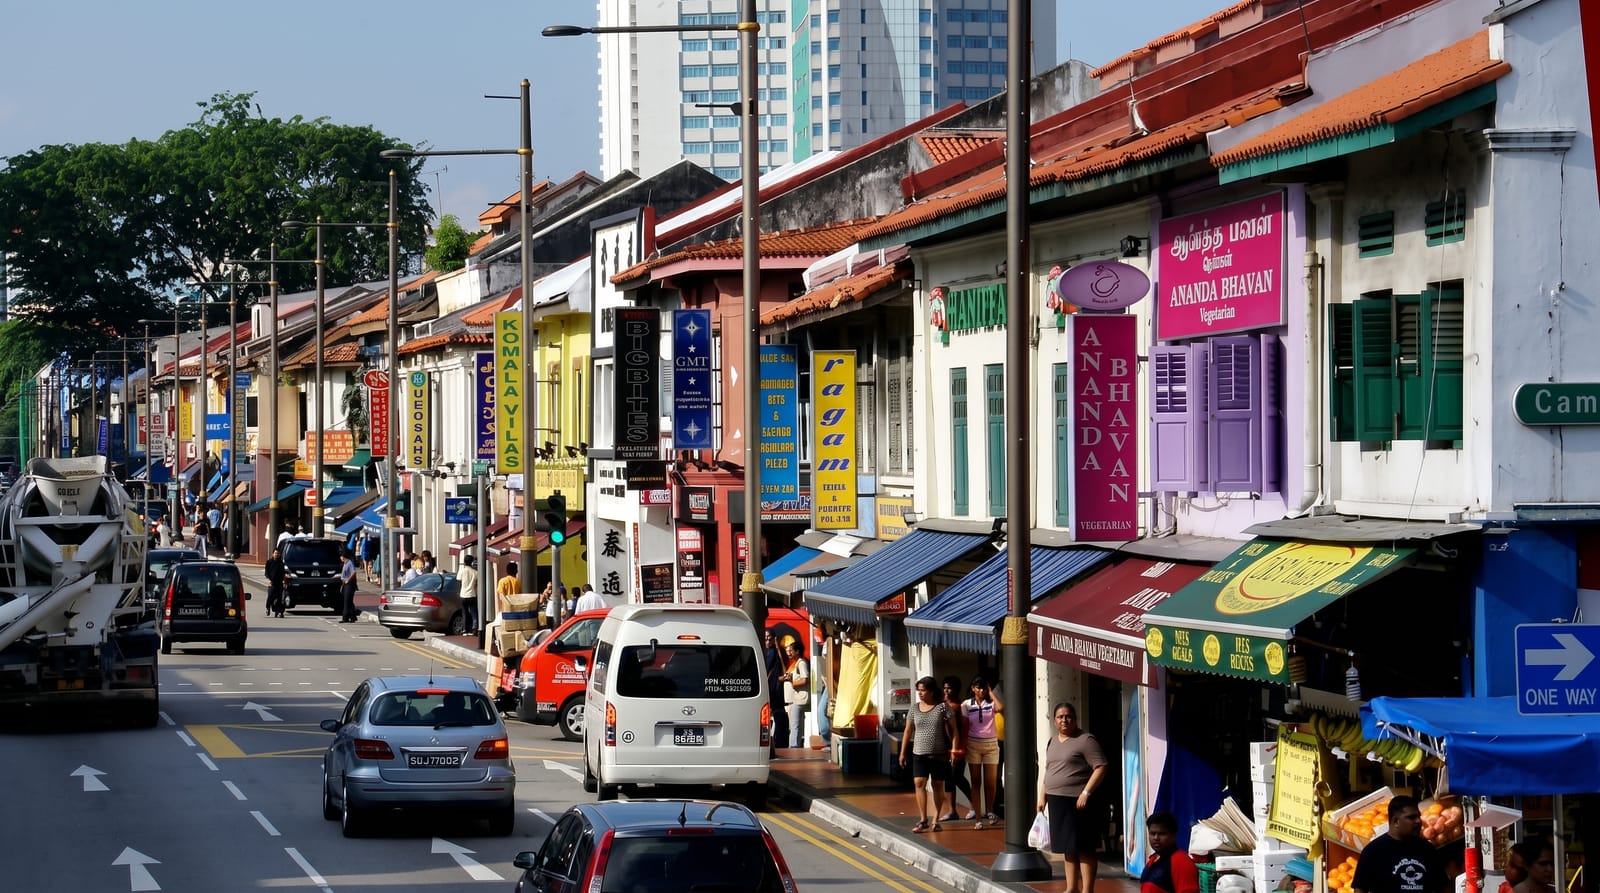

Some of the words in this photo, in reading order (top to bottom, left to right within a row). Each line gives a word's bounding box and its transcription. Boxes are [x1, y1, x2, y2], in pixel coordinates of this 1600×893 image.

[1169, 279, 1218, 308] ANANDA
[1220, 269, 1274, 300] BHAVAN
[1199, 304, 1236, 326] Vegetarian
[502, 319, 520, 397] KOMALA
[676, 356, 709, 367] GMT
[817, 358, 850, 472] ragam
[1080, 327, 1102, 471] ANANDA
[1535, 388, 1598, 414] Cam
[503, 404, 519, 468] VILAS
[1108, 358, 1130, 503] BHAVAN
[1080, 520, 1132, 530] VEGETARIAN
[1050, 633, 1074, 653] ANANDA
[1097, 644, 1135, 668] VEGETARIAN
[1525, 687, 1559, 706] ONE
[1564, 687, 1598, 705] WAY
